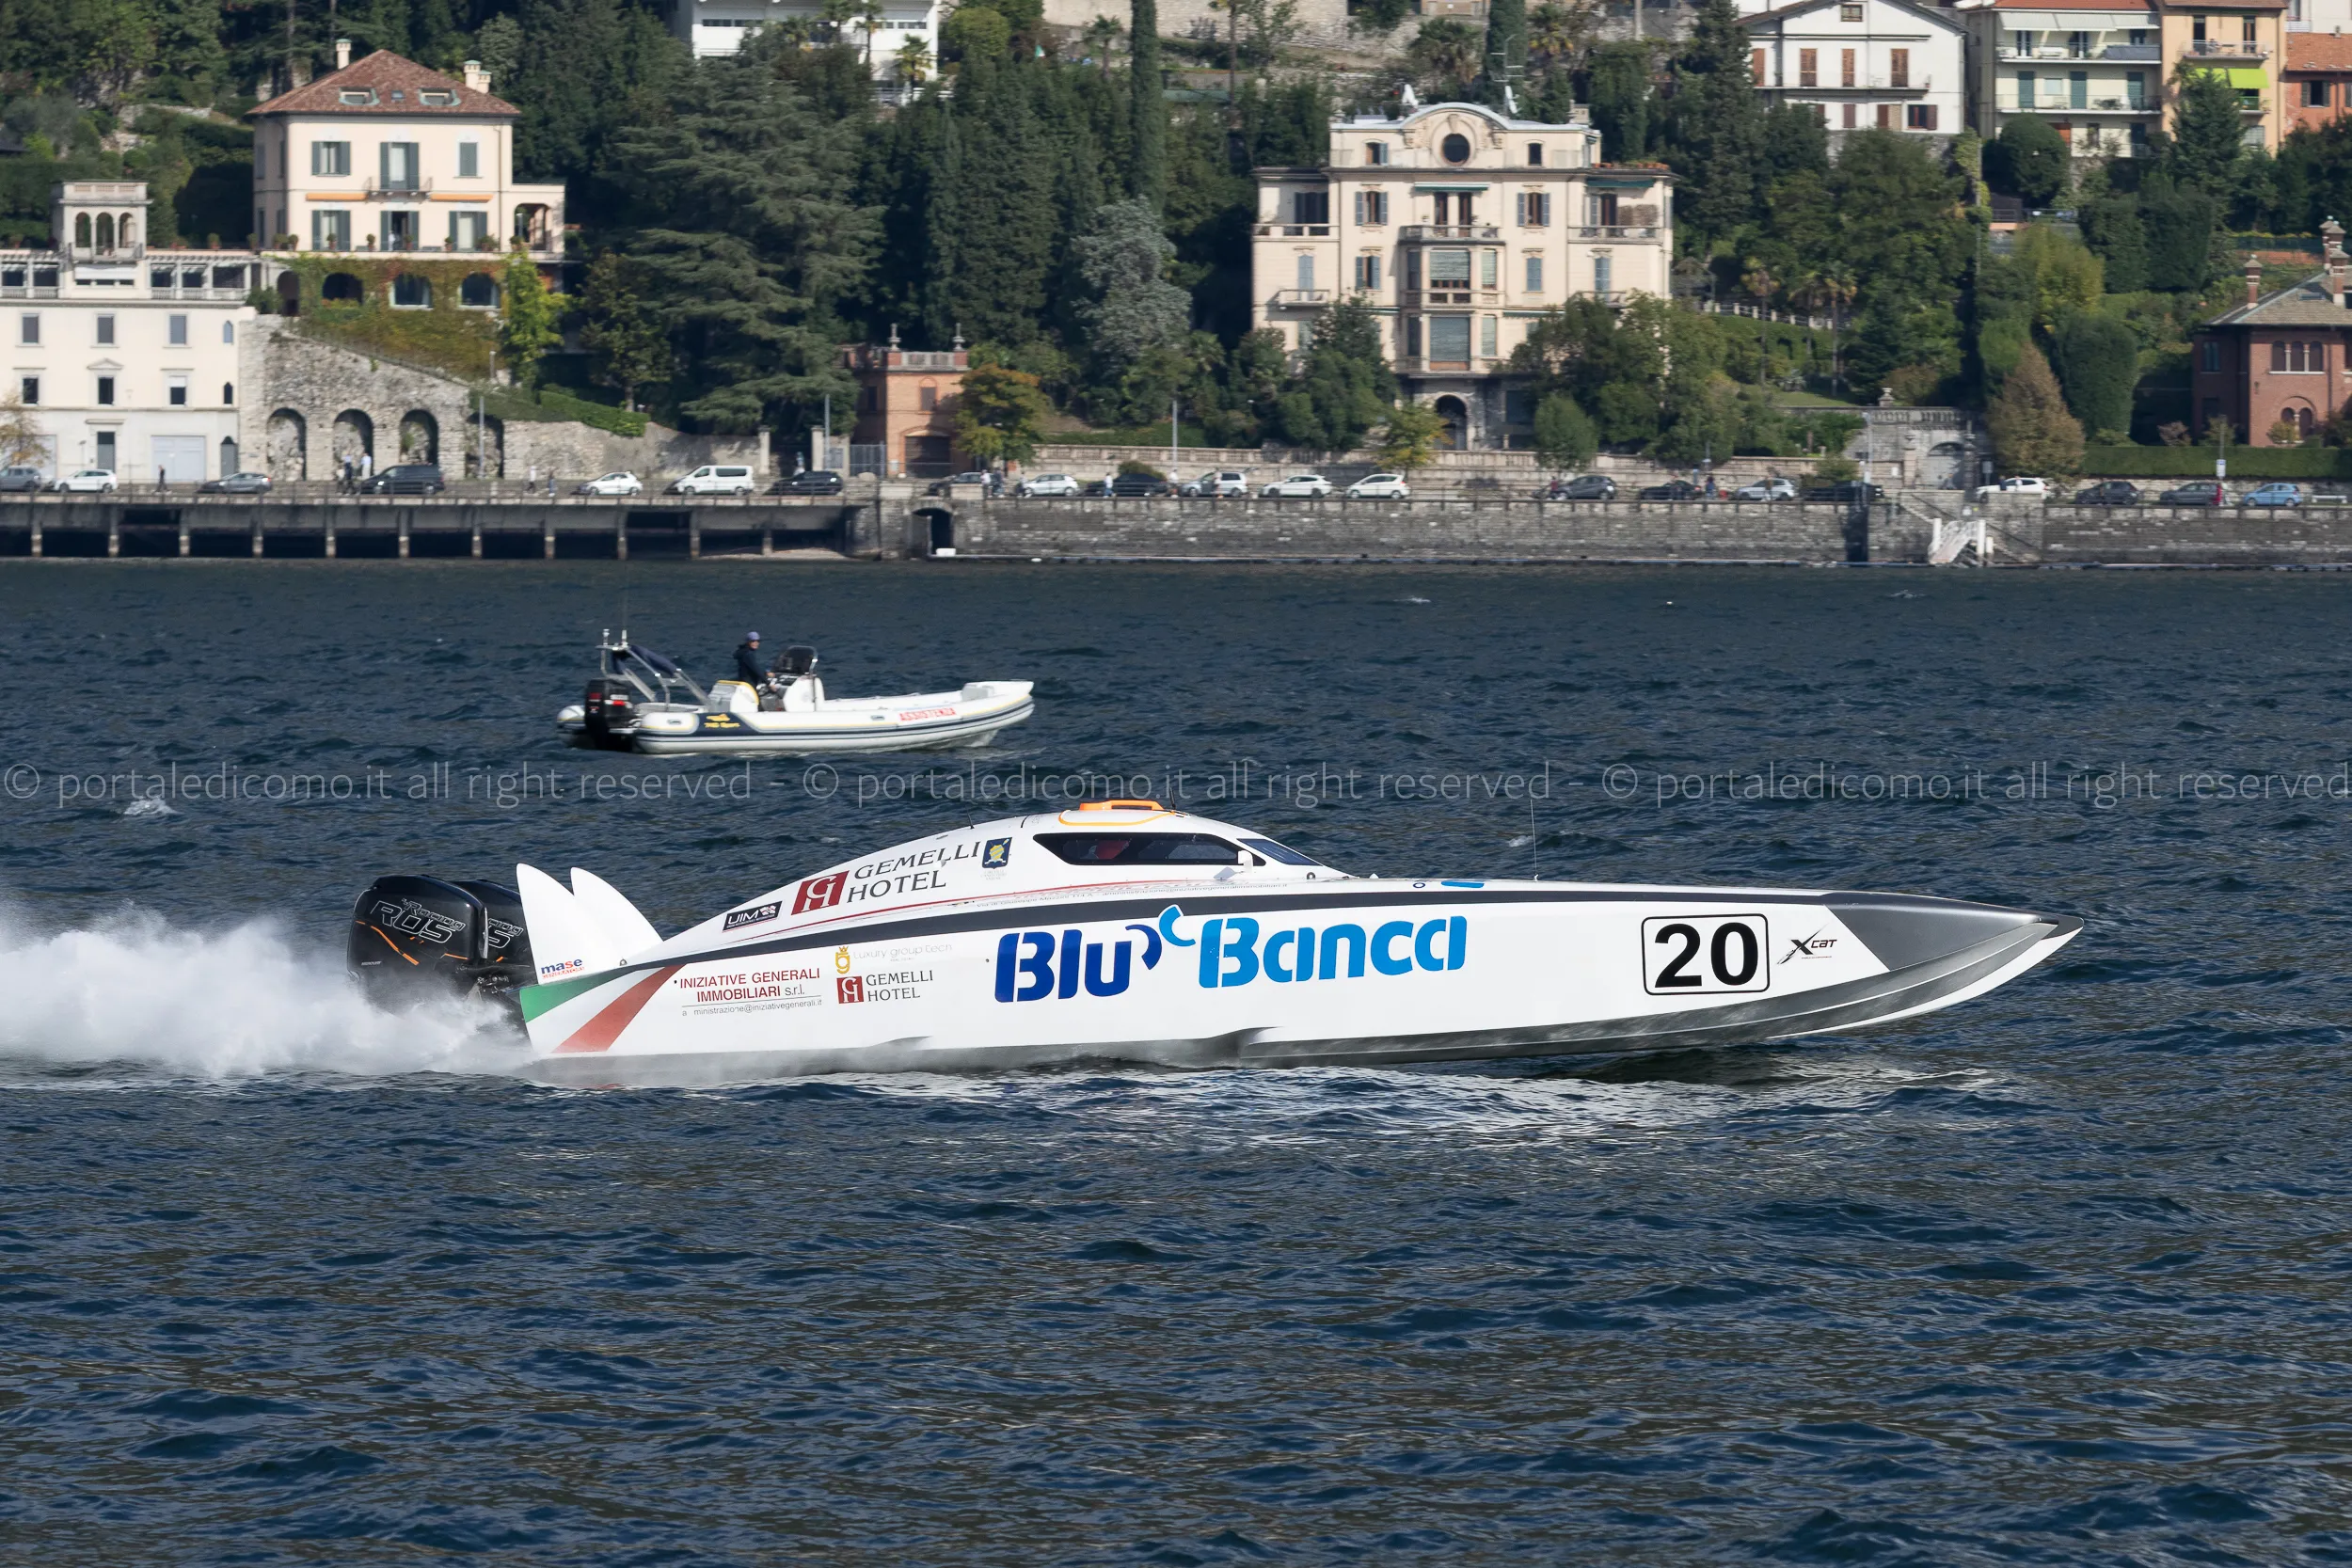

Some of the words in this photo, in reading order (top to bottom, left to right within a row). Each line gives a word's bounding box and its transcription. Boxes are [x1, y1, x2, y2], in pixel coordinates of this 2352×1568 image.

[854, 841, 980, 879] GEMELLI
[847, 870, 946, 903] HOTEL
[370, 900, 453, 943] ROS
[402, 898, 466, 932] Racing
[728, 910, 759, 925] UIM
[890, 945, 923, 958] group
[994, 926, 1133, 1004] Blu
[1198, 915, 1467, 989] Banca
[1654, 922, 1758, 988] 20
[541, 958, 583, 974] mase
[679, 974, 747, 989] INIZIATIVE
[752, 968, 820, 984] GENERALI
[866, 970, 933, 986] GEMELLI
[697, 985, 781, 1003] IMMOBILIARI
[785, 984, 805, 996] s.r.l.
[867, 987, 921, 1002] HOTEL
